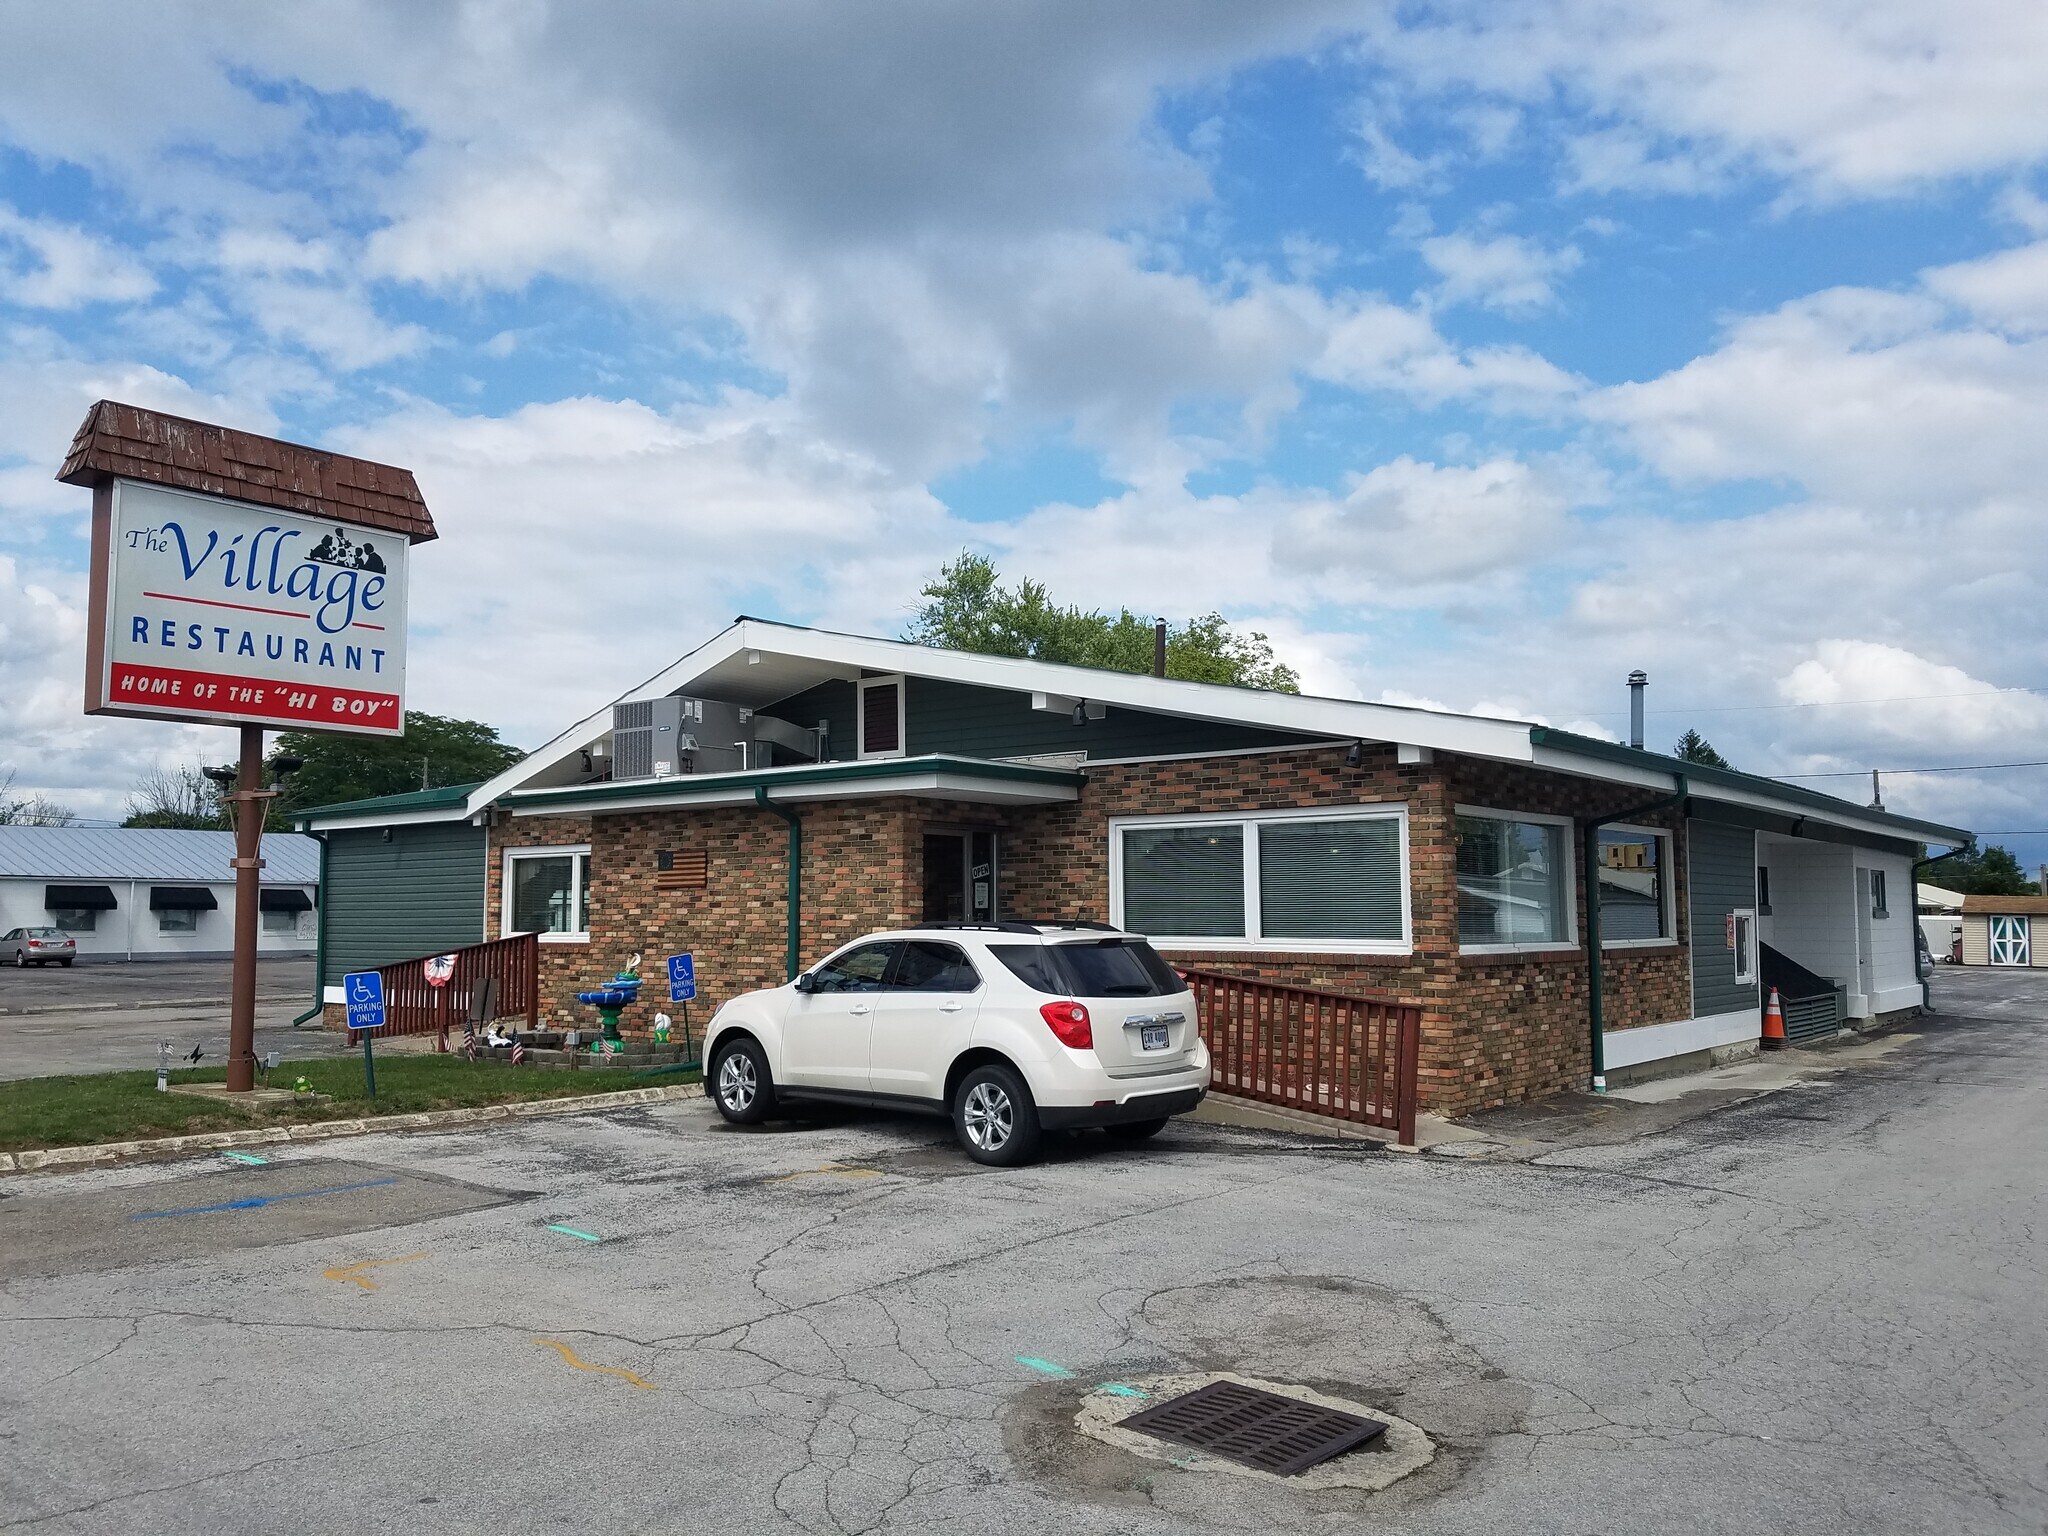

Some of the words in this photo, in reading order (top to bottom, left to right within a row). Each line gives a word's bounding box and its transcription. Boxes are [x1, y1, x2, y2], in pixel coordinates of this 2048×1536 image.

[125, 527, 168, 553] The
[160, 522, 385, 633] Village
[132, 616, 386, 674] RESTAURANT
[121, 674, 182, 696] HOME
[193, 683, 218, 699] OF
[229, 686, 265, 704] THE
[973, 864, 989, 878] OPEN
[671, 978, 694, 989] PARKING
[676, 988, 690, 998] ONLY
[349, 1001, 382, 1013] PARKING
[356, 1012, 376, 1023] ONLY
